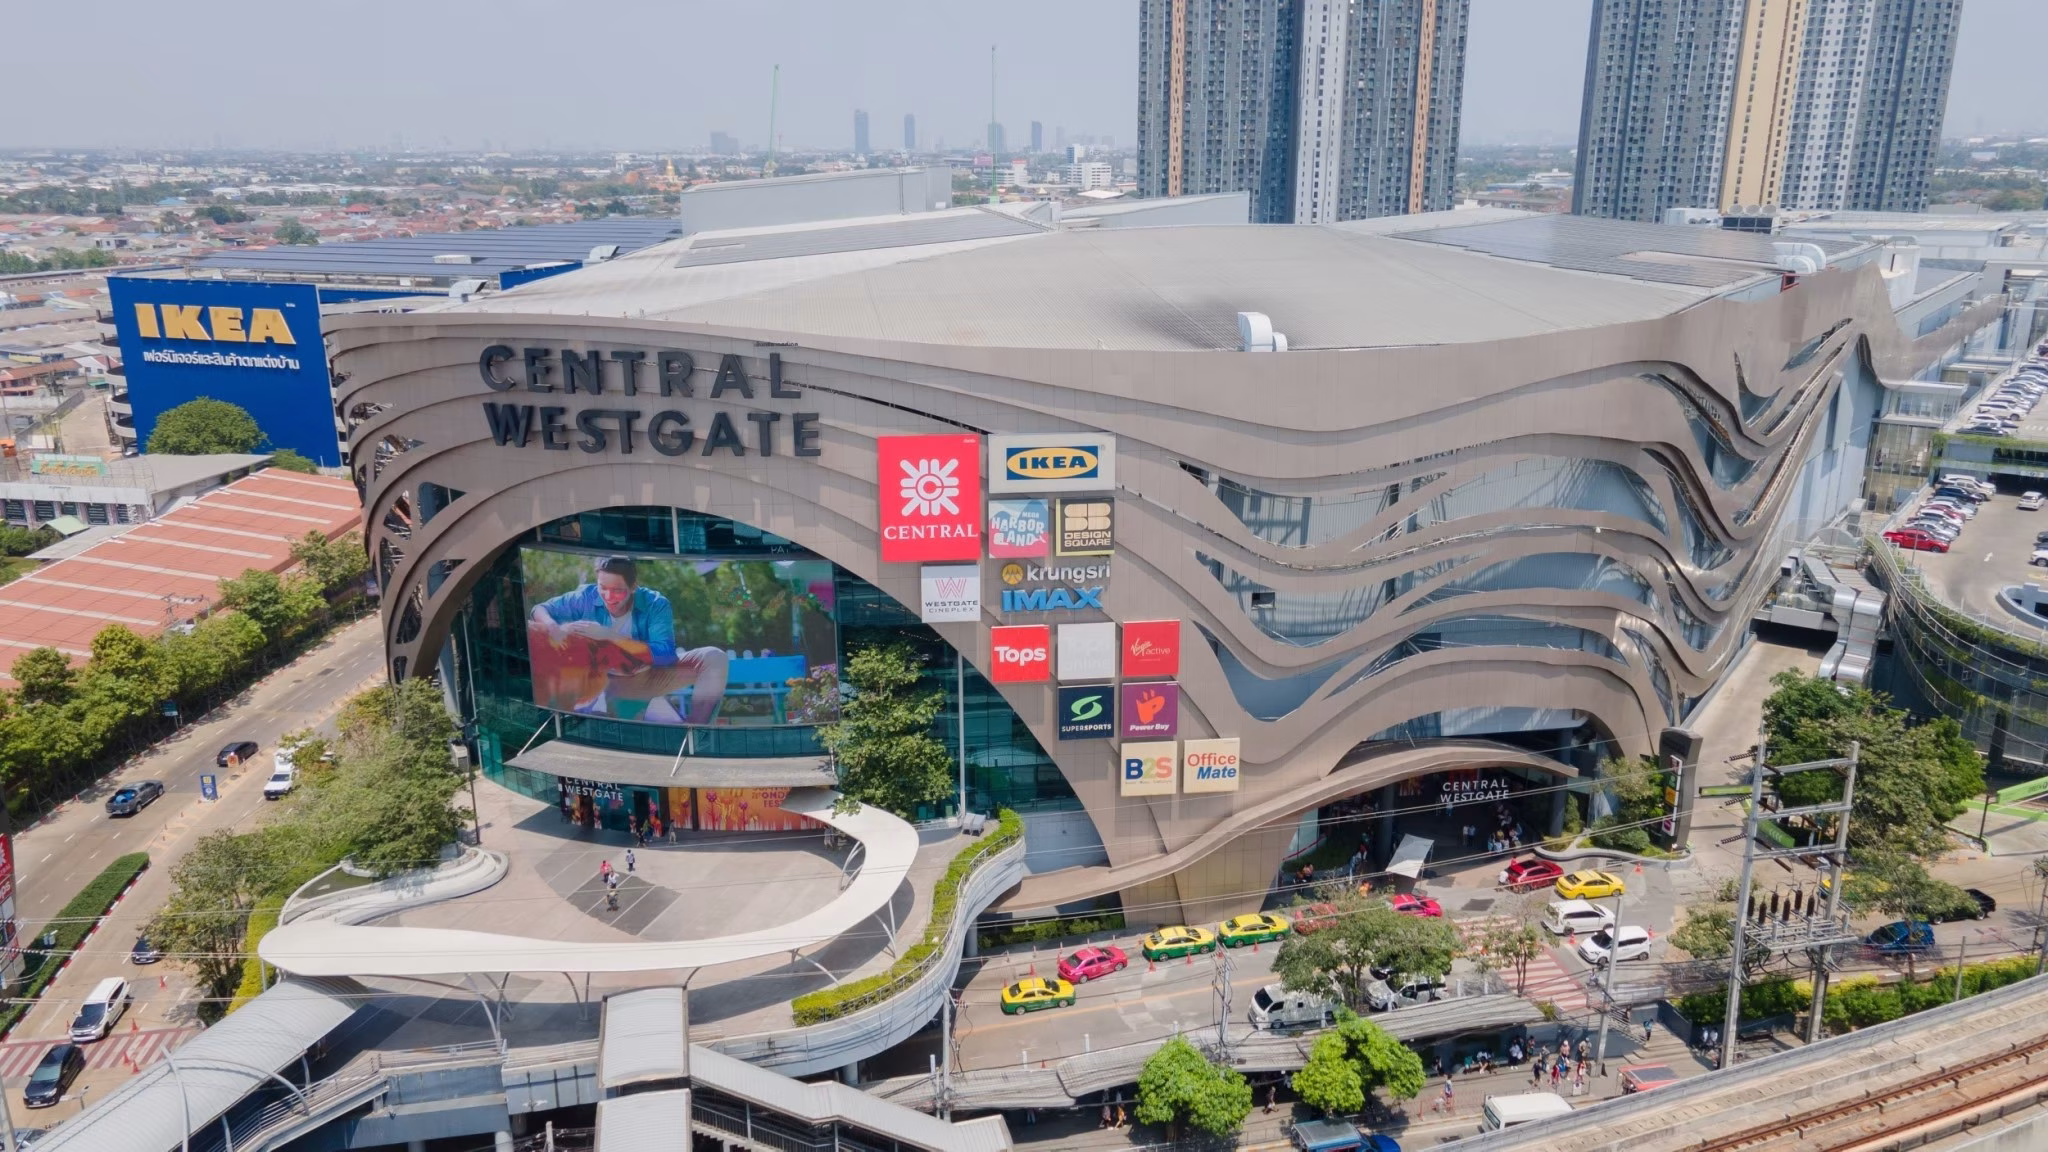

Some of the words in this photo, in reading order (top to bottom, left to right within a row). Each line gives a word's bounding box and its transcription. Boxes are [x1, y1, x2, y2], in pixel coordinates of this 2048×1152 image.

[134, 303, 297, 345] IKEA
[479, 344, 802, 399] CENTRAL
[483, 402, 822, 457] WESTGATE
[1019, 456, 1088, 470] IKEA
[883, 524, 979, 540] CENTRAL
[991, 517, 1045, 535] HARBOR
[1064, 531, 1112, 539] DESIGN
[1064, 539, 1112, 548] SQUARE
[1026, 561, 1111, 583] krungsri
[1002, 586, 1104, 612] IMAX
[994, 646, 1047, 667] Tops
[1146, 647, 1171, 655] active
[1062, 724, 1112, 732] SUPERSPORTS
[1155, 723, 1170, 731] Buy
[1187, 753, 1237, 767] Office
[1125, 757, 1173, 780] B2S
[1197, 766, 1237, 780] Mate
[565, 777, 621, 791] CENTRAL
[1442, 779, 1508, 791] CENTRAL
[565, 785, 624, 801] WESTGATE
[1440, 790, 1509, 803] WESTGATE
